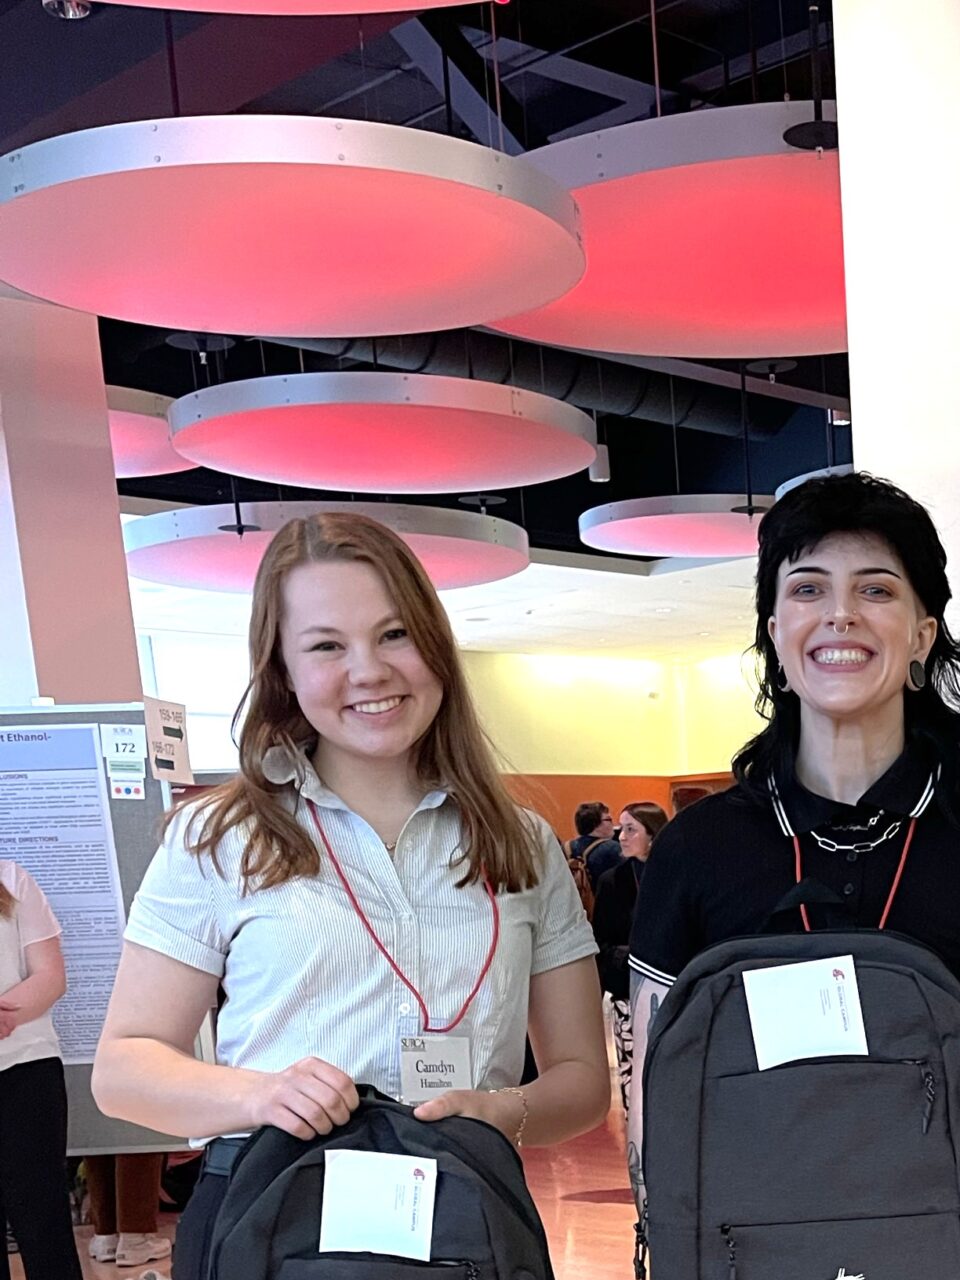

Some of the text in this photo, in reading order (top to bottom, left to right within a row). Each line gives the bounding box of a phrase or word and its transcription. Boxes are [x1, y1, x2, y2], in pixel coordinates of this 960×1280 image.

[7, 732, 52, 742] Ethanol-
[115, 742, 136, 753] 172
[415, 1059, 456, 1076] Camdyn
[420, 1078, 453, 1089] Hamilton
